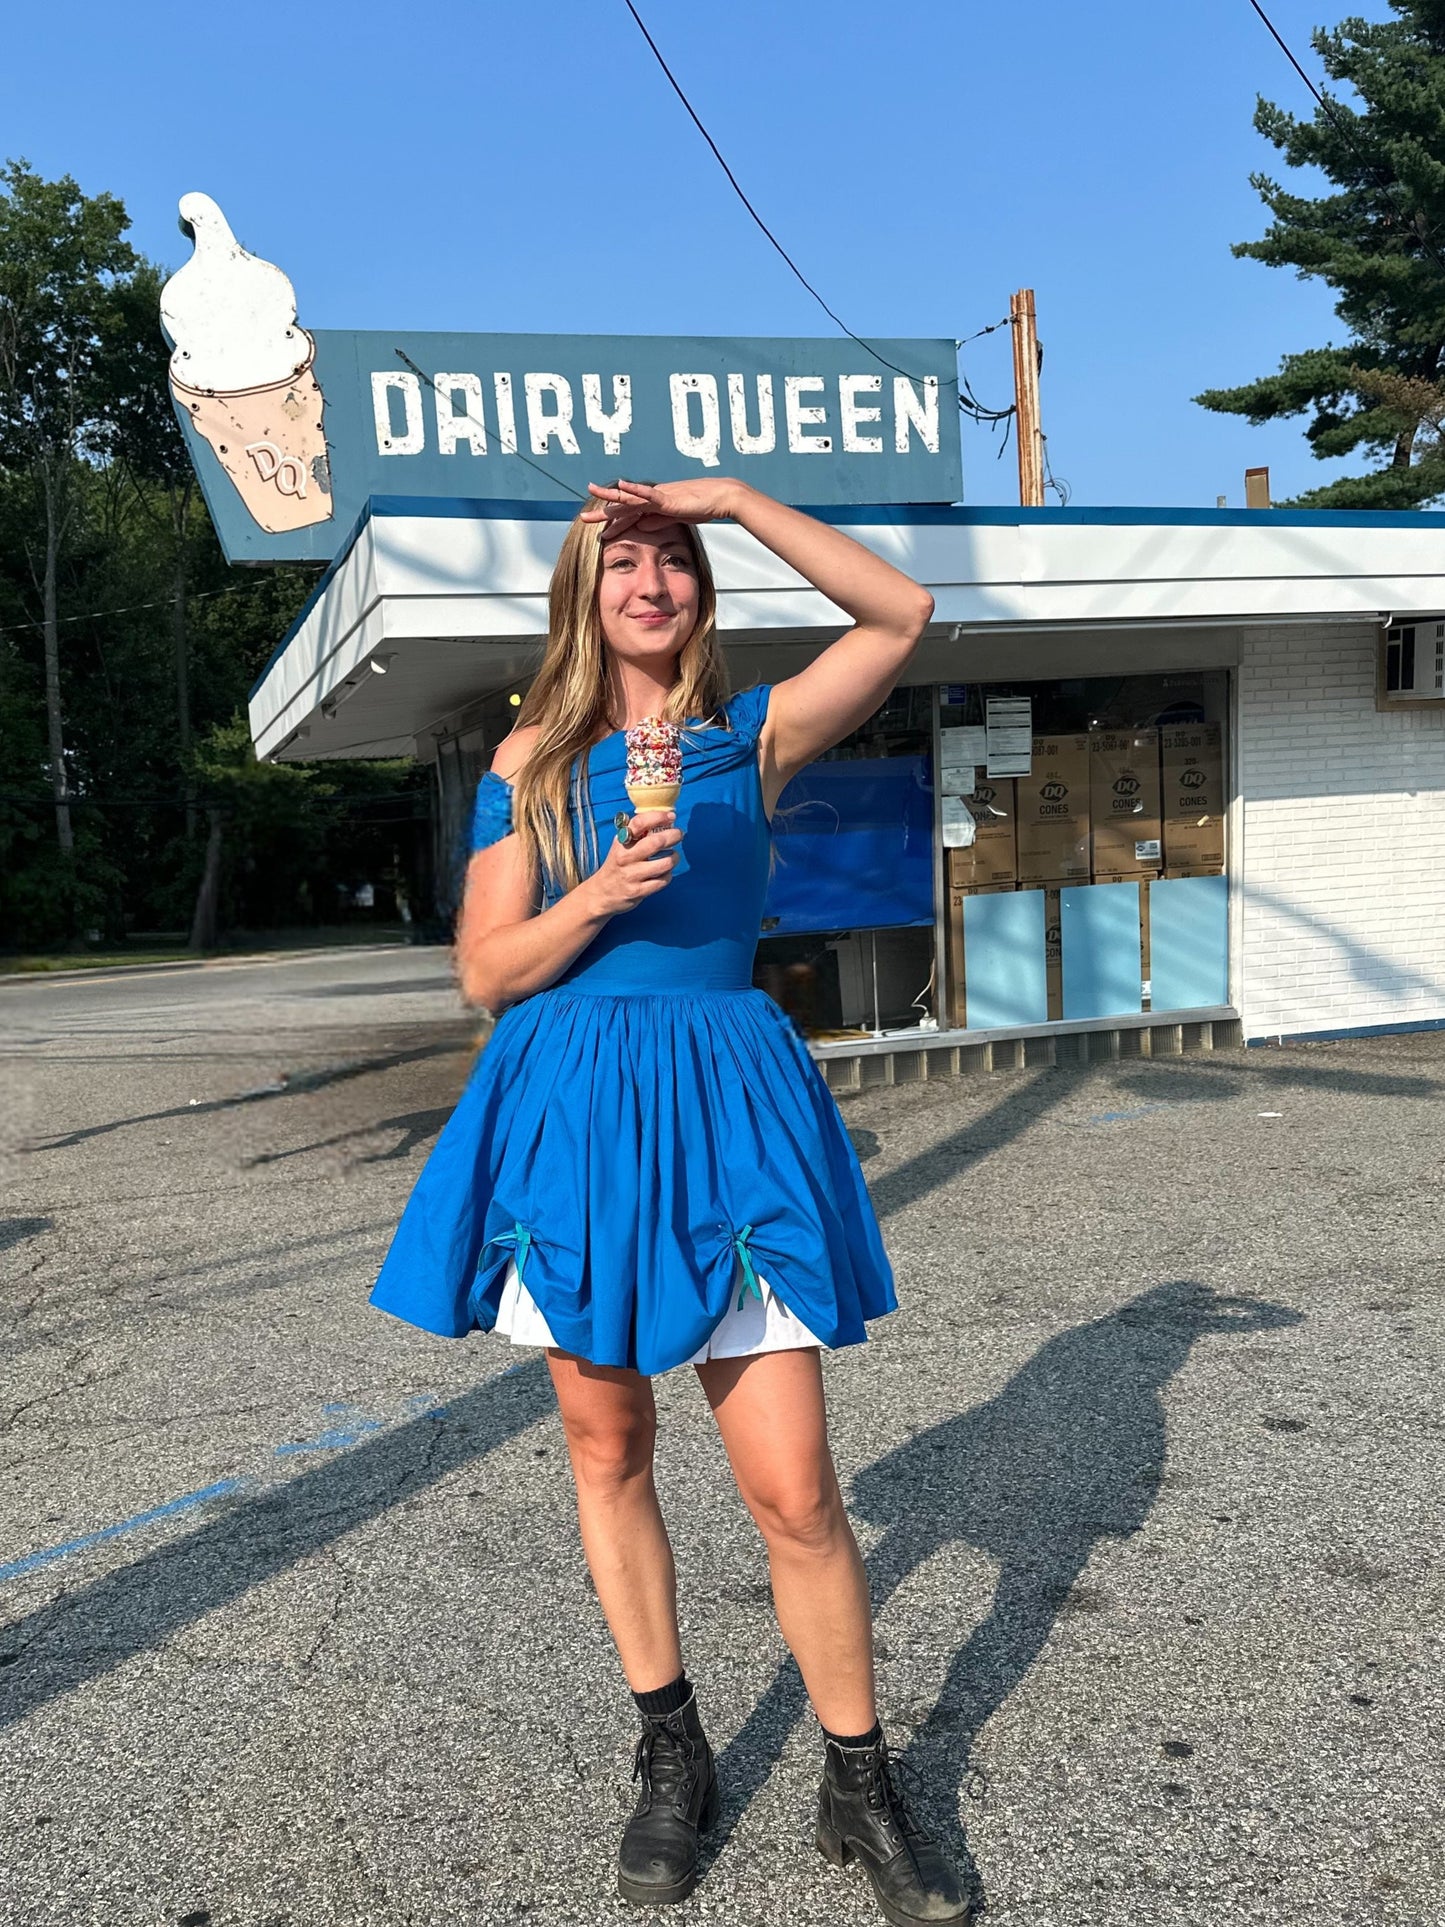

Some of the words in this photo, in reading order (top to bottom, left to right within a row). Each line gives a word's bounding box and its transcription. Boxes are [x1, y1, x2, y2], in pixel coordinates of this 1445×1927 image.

[370, 371, 634, 457] DAIRY
[669, 372, 941, 468] QUEEN
[246, 439, 308, 500] DQ
[1184, 772, 1204, 786] DQ
[1044, 785, 1066, 798] DQ
[1117, 780, 1138, 793] DQ
[972, 788, 993, 802] DQ
[1179, 796, 1208, 807] CONES
[1039, 804, 1069, 815] CONES
[1112, 798, 1141, 809] CONES
